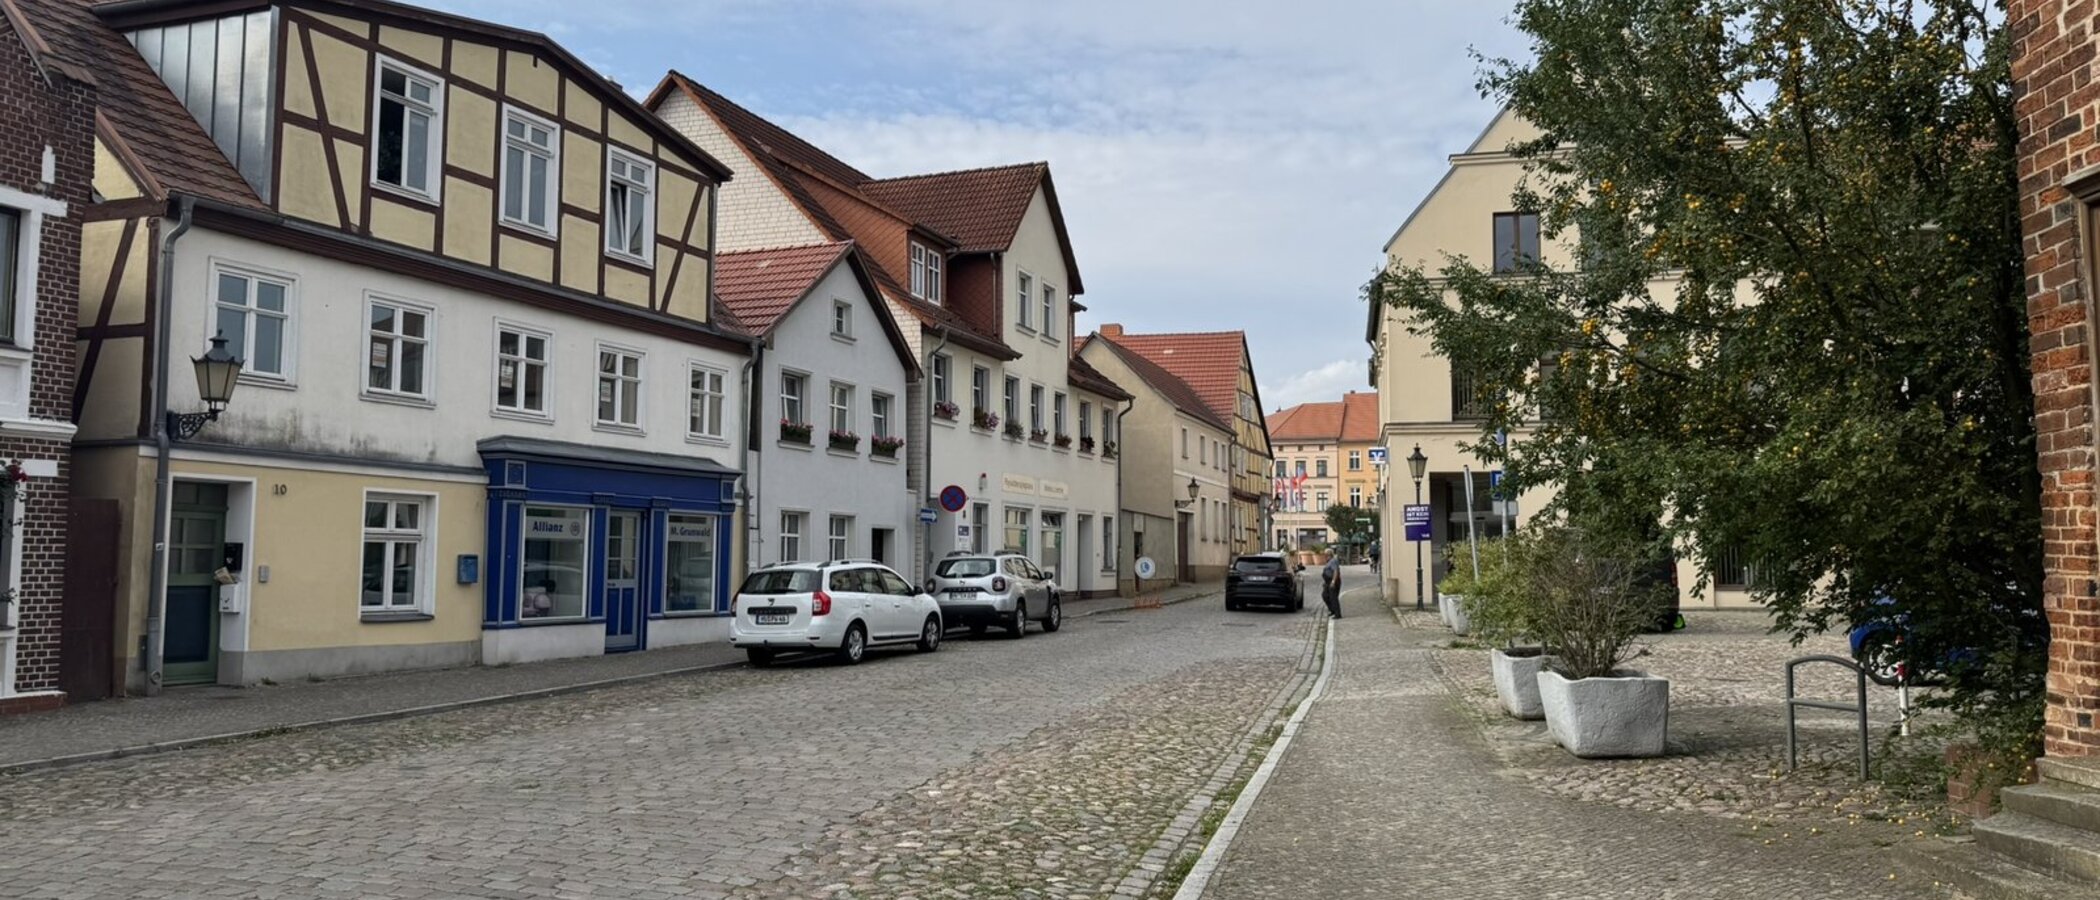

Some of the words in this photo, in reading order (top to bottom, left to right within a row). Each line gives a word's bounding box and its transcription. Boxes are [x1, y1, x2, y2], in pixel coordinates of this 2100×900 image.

[274, 483, 287, 495] 10
[532, 521, 563, 533] Allianz
[670, 526, 679, 535] M.
